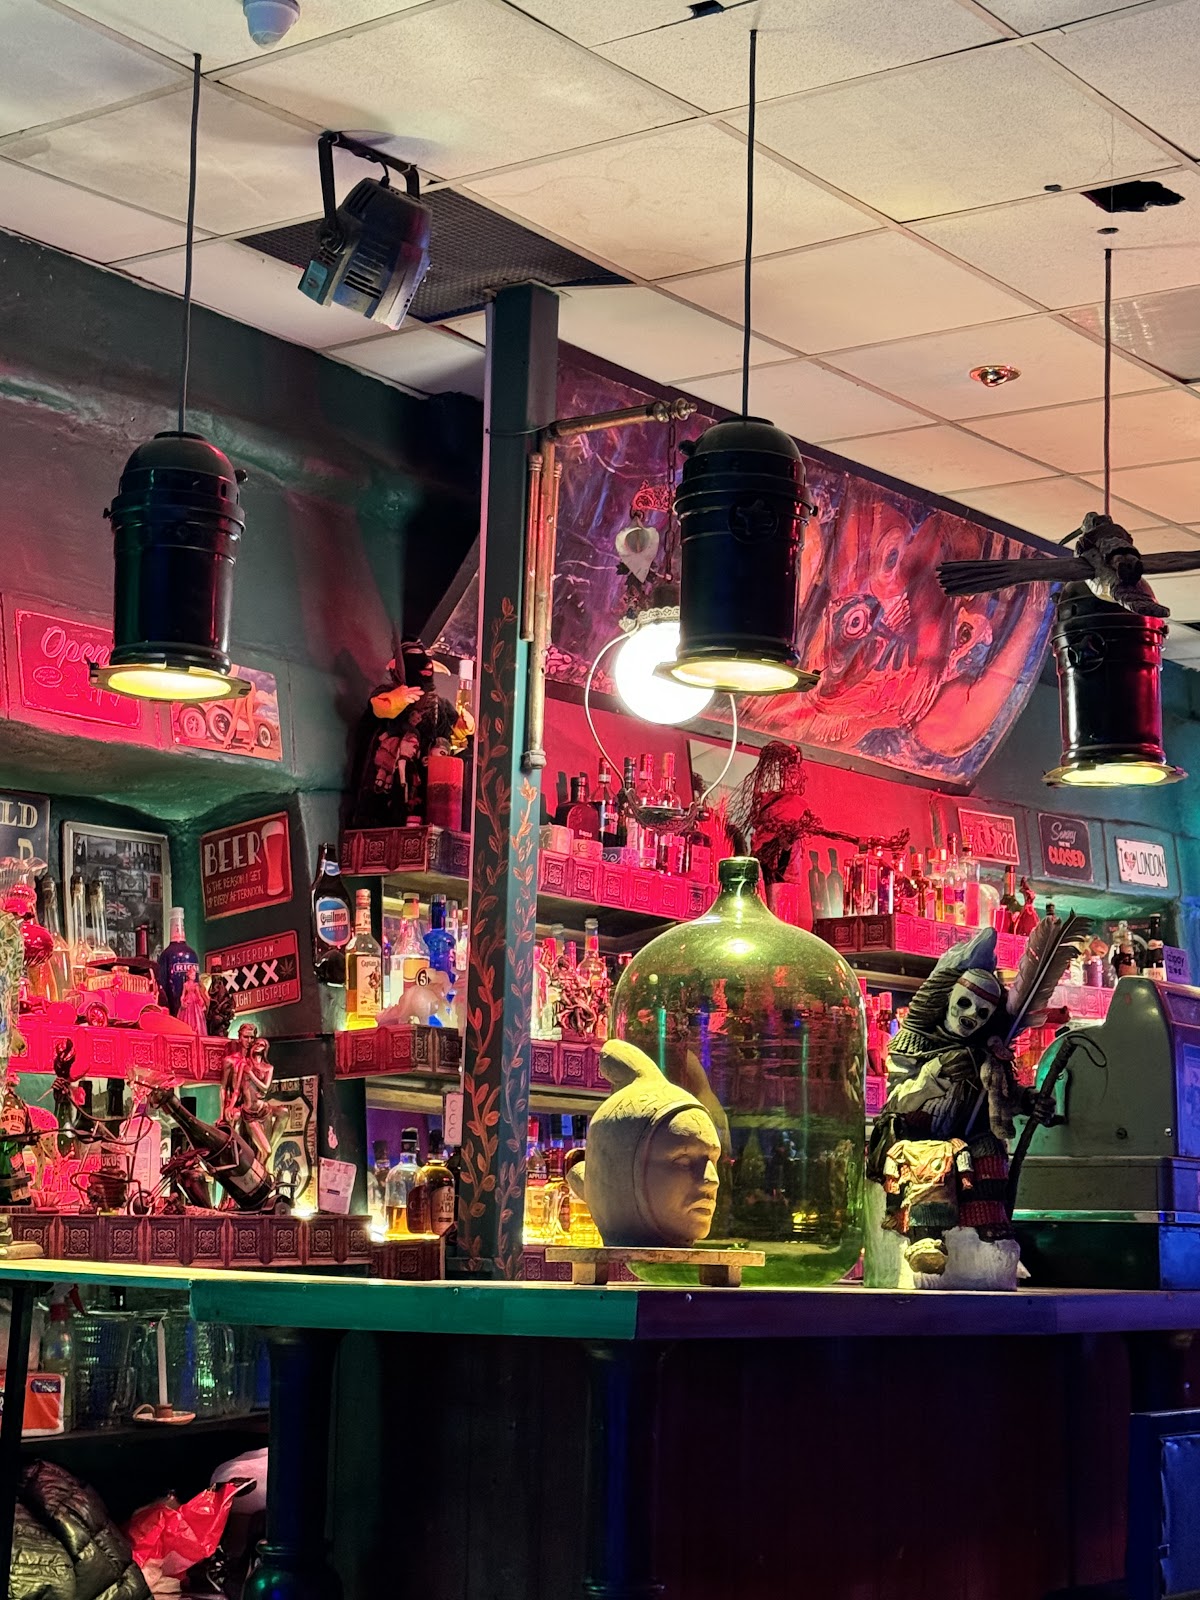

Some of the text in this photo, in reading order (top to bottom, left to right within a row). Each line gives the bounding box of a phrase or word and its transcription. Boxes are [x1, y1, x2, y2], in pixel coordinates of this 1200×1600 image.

[41, 626, 109, 668] Open
[204, 831, 262, 877] BEER
[1048, 845, 1085, 868] CLOSED
[1119, 848, 1165, 878] I LONDON
[226, 945, 274, 967] AMSTERDAM
[419, 973, 427, 986] 5
[235, 983, 290, 1007] IGHT DISTRICT
